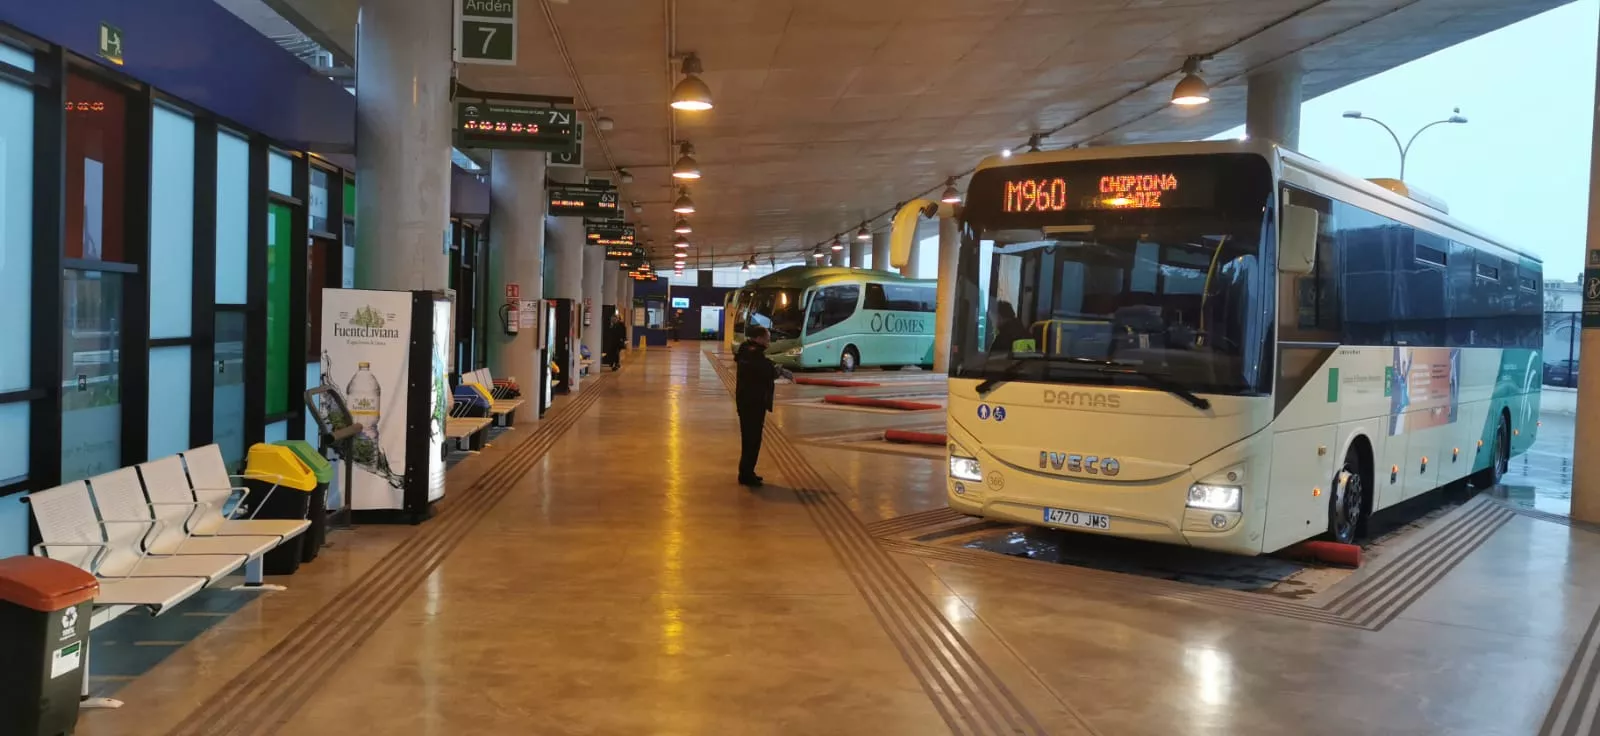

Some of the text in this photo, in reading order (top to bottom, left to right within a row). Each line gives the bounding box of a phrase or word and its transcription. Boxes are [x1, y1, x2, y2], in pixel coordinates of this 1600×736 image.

[466, 0, 511, 12] Andén
[478, 27, 497, 55] 7
[549, 111, 558, 124] 7
[1099, 174, 1177, 192] CHIPIONA
[1003, 178, 1066, 212] M960
[334, 322, 399, 338] FuenteLiviana
[1044, 390, 1120, 408] DAMAS
[1039, 450, 1120, 477] IVECO
[1050, 510, 1107, 528] 4770 JMS
